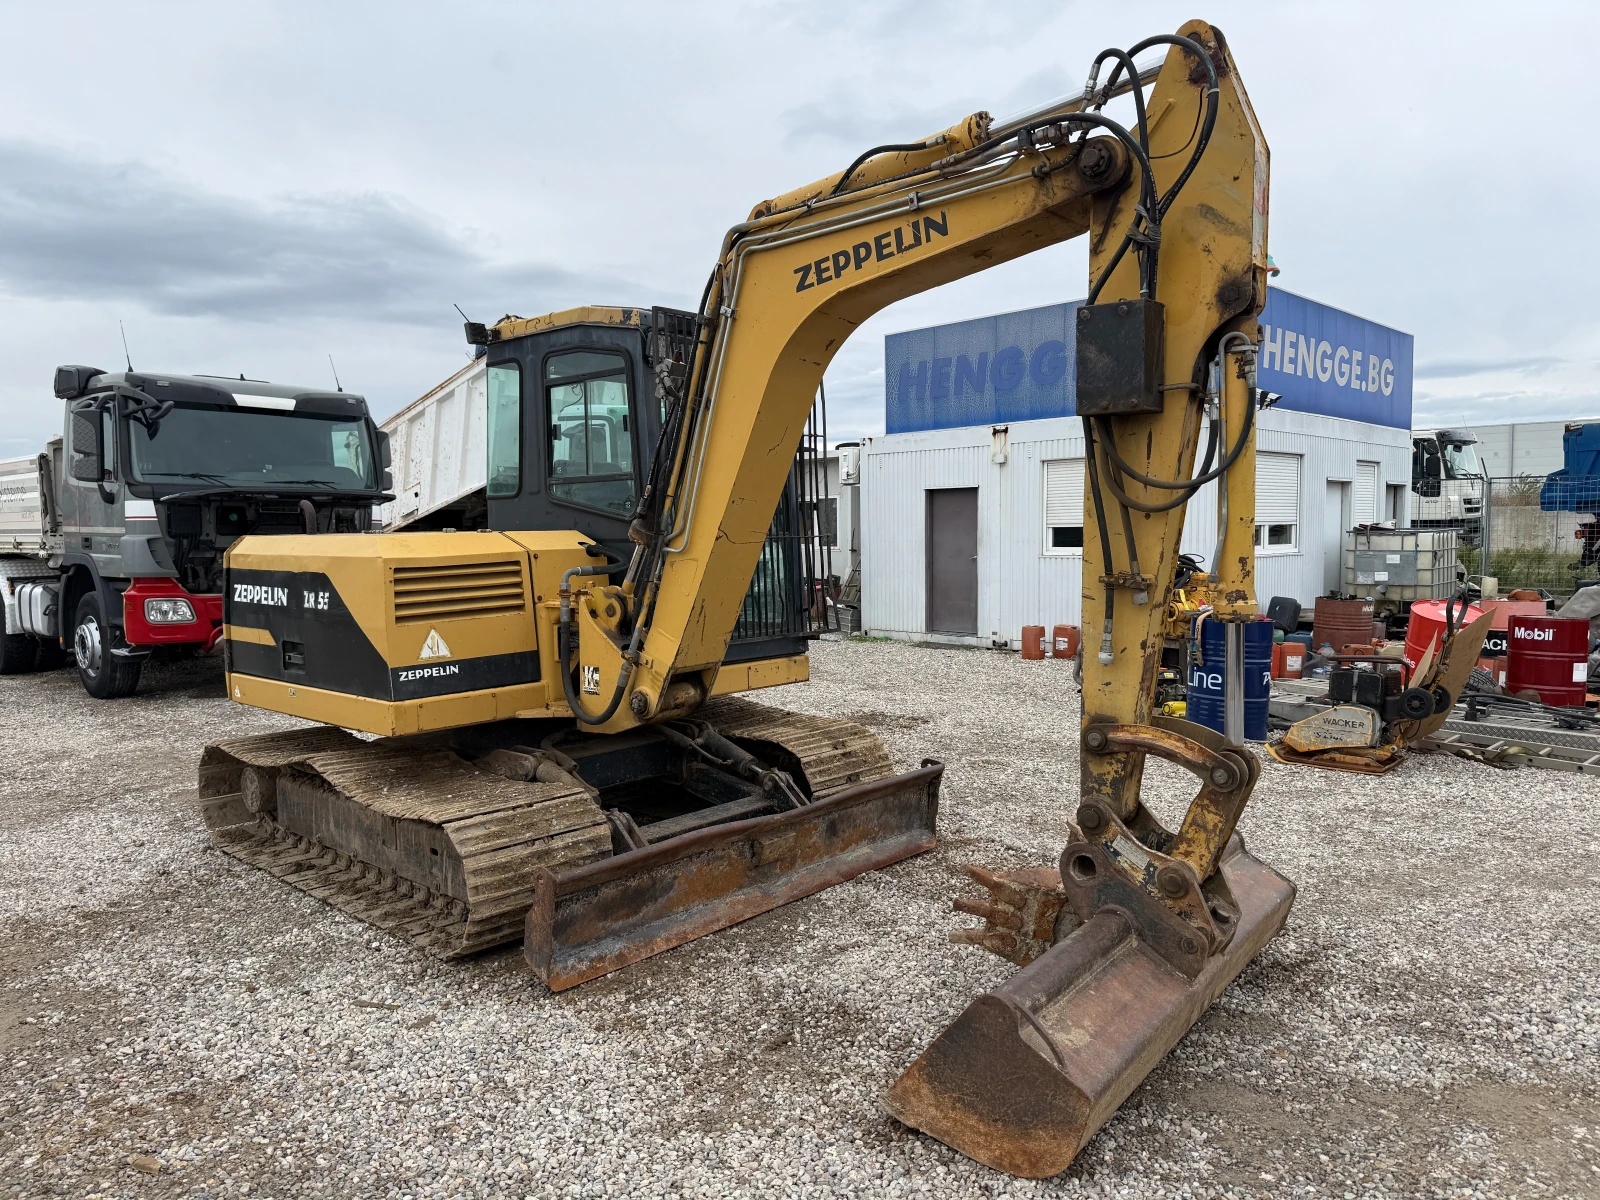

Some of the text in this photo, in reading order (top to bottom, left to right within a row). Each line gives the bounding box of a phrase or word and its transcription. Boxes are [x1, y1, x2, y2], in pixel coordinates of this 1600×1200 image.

[794, 210, 948, 293] ZEPPELIN
[899, 340, 1076, 401] HENGG
[1263, 324, 1394, 396] HENGGE.BG
[233, 584, 288, 607] ZEPPELIN
[317, 591, 330, 611] 55
[1514, 626, 1554, 641] Mobil
[399, 664, 459, 681] ZEPPELIN
[1323, 717, 1365, 730] WACKER
